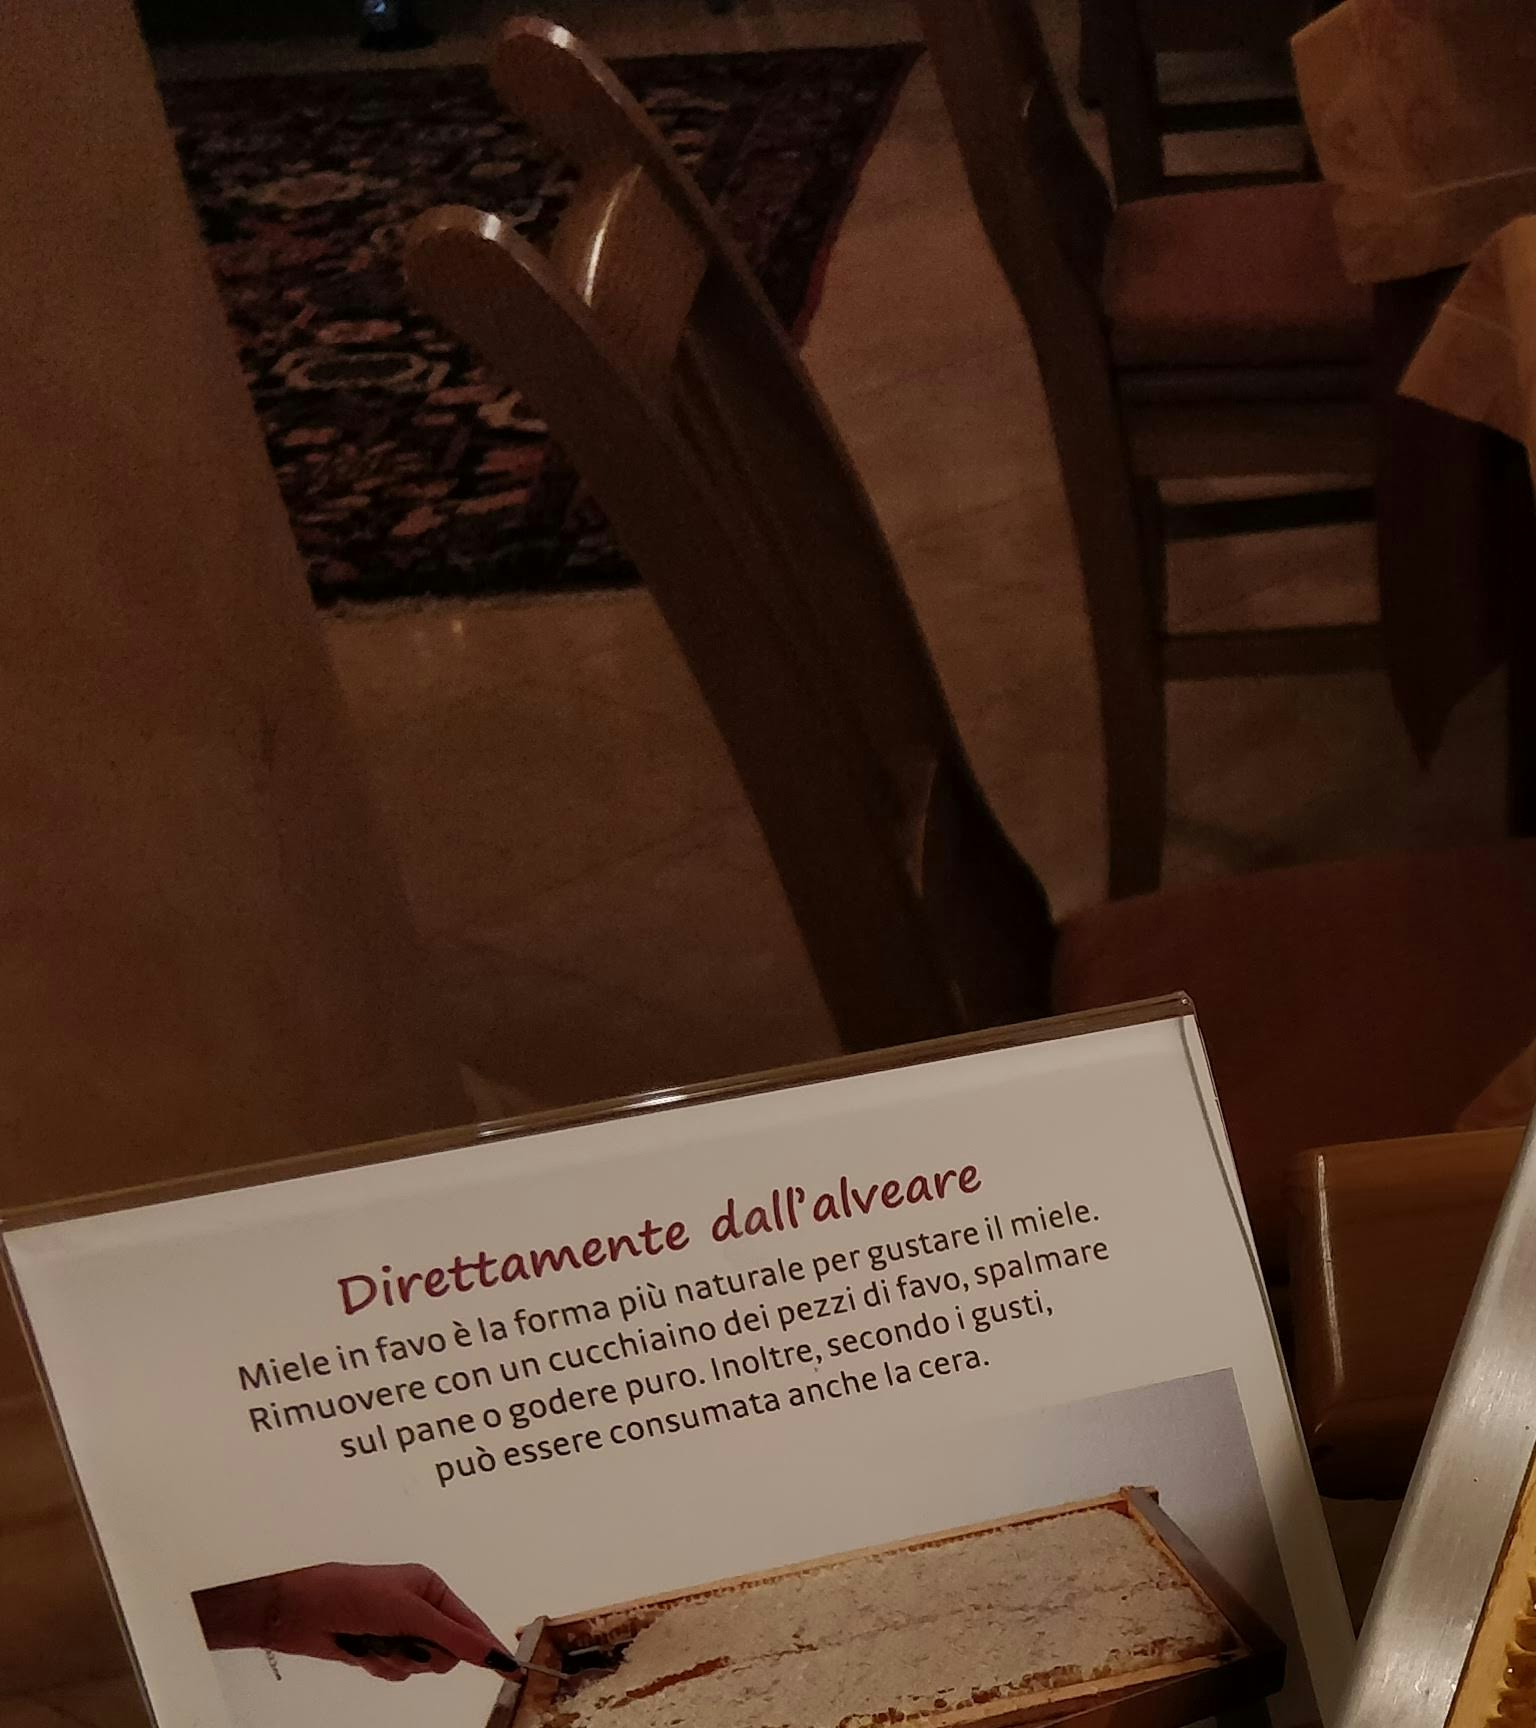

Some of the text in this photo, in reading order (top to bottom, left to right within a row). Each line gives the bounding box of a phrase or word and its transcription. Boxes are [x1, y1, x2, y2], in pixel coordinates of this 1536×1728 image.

[237, 1200, 1100, 1392] Miele in favo è la forma più naturale per gustare il miele.
[336, 1164, 982, 1316] Direttamente dall'alveare
[248, 1241, 1110, 1433] Rimuovere con un cucchiaino dei pezzi di favo, spalmare
[339, 1289, 1053, 1459] sul pane o godere puro. Inoltre, secondo i gusti,
[434, 1350, 990, 1489] può essere consumata anche la cera.
